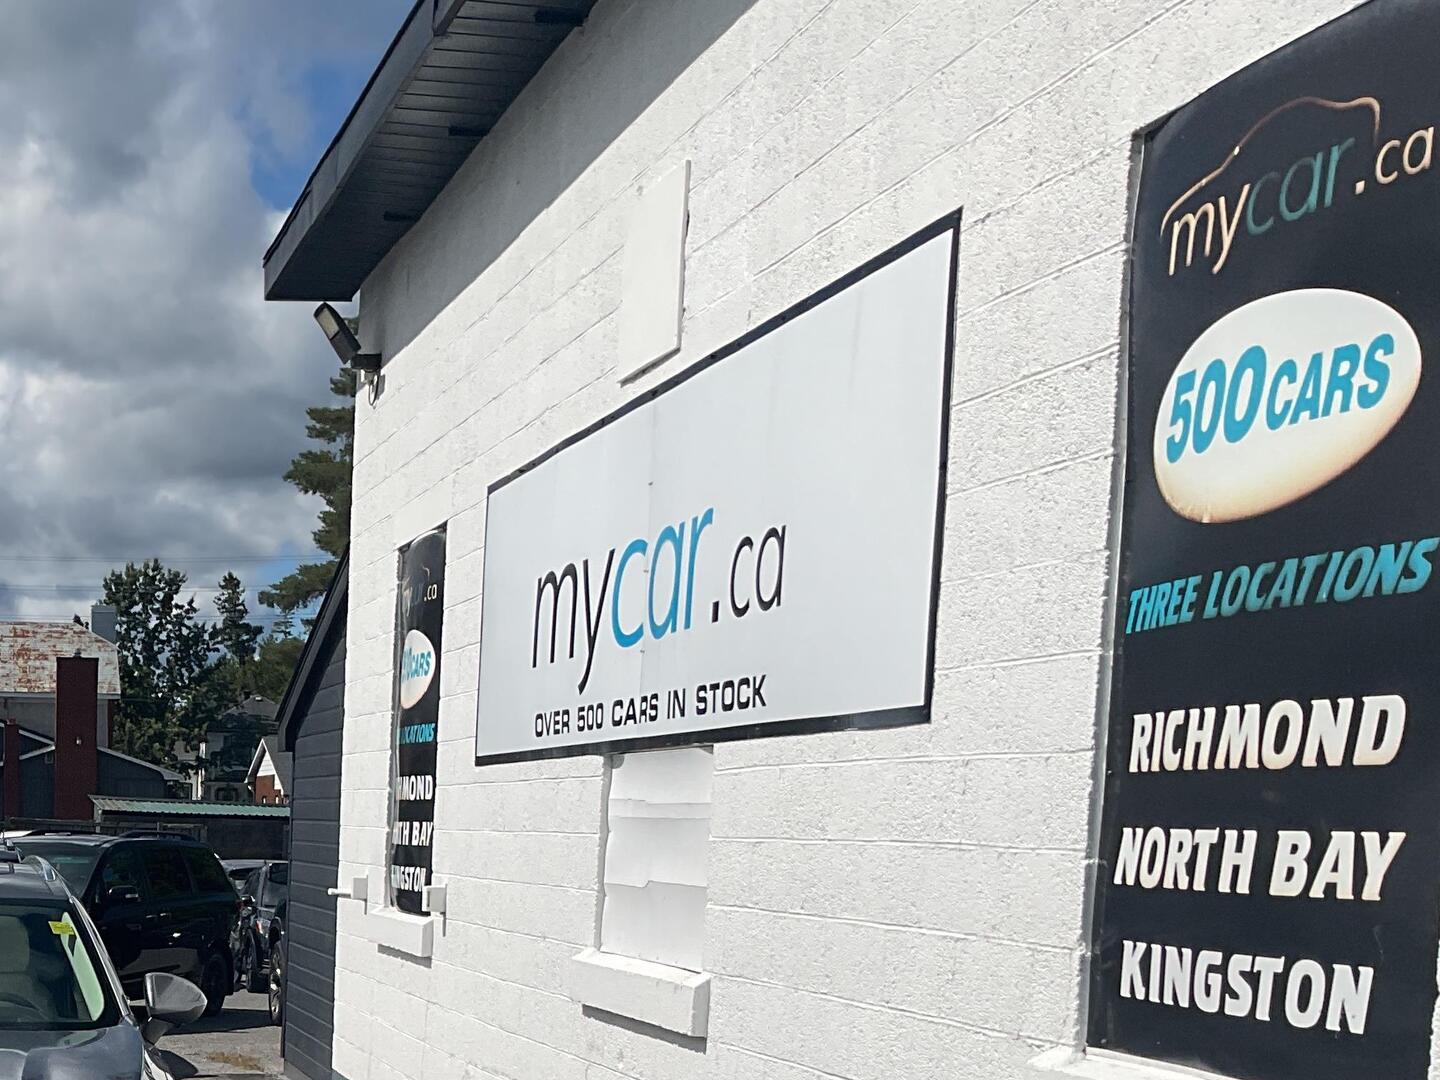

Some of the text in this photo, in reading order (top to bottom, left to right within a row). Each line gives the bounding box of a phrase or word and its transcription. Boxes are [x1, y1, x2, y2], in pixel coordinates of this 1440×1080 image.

[531, 507, 787, 696] mycar.ca
[1125, 536, 1439, 634] THREE LOCATIONS
[534, 674, 768, 738] OVER 500 CARS IN STOCK
[1128, 694, 1407, 774] RICHMOND
[411, 821, 434, 847] BAY
[1113, 826, 1408, 901] NORTH BAY
[1119, 939, 1375, 1035] KINGSTON
